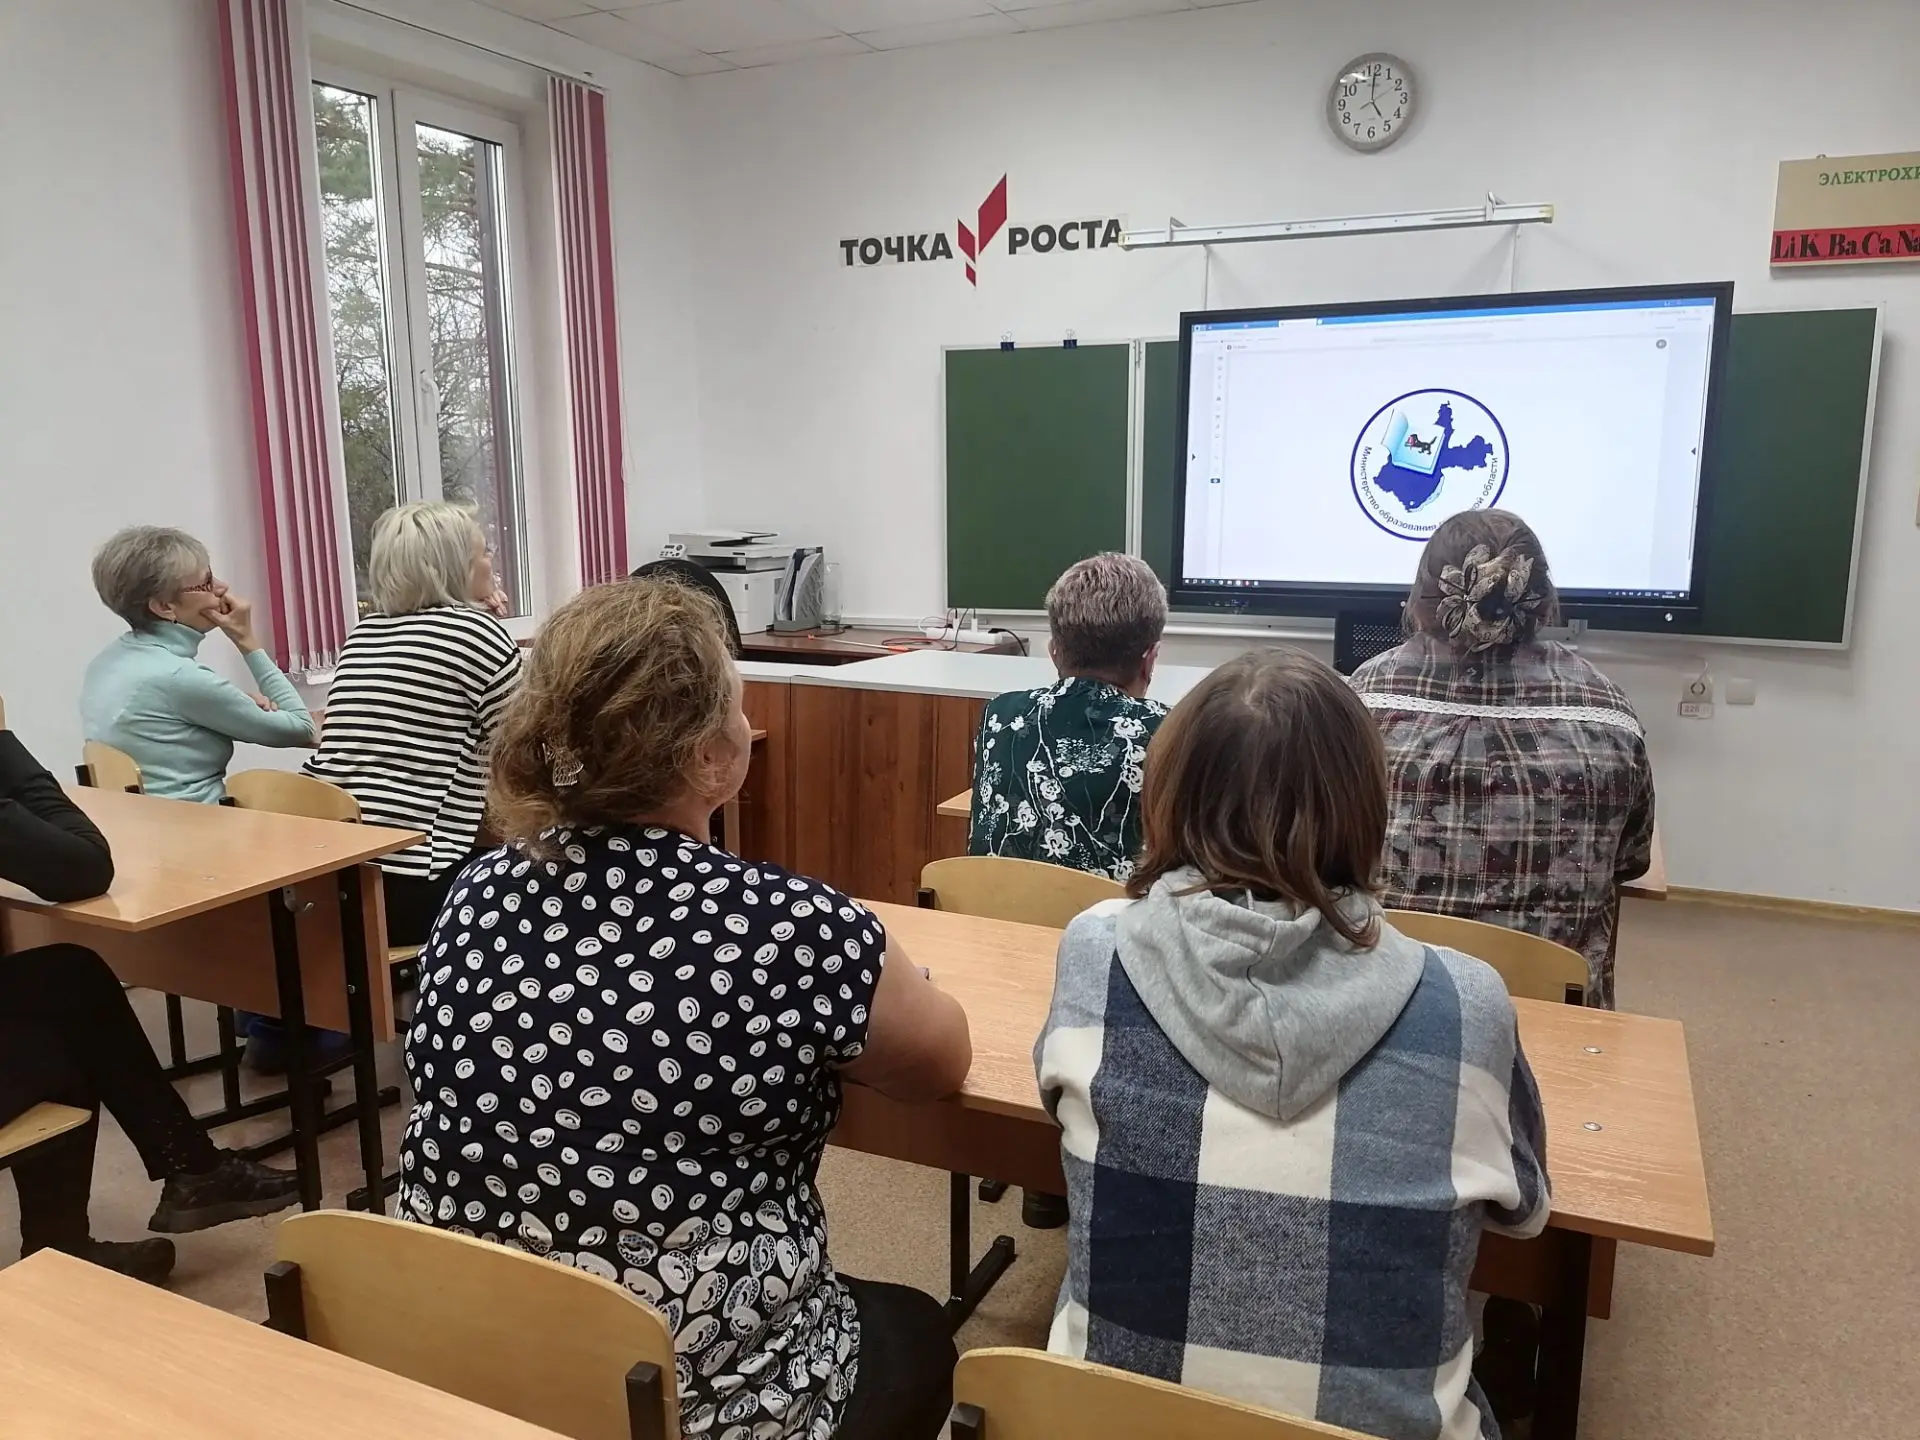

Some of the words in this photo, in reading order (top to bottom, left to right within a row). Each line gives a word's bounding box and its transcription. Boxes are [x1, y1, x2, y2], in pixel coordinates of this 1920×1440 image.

[1367, 64, 1382, 77] 12
[1386, 67, 1392, 80] 1
[1343, 83, 1357, 97] 10
[1394, 78, 1403, 91] 2
[1338, 99, 1346, 111] 9
[1400, 92, 1408, 105] 3
[1342, 112, 1351, 124] 8
[1393, 107, 1402, 119] 4
[1353, 123, 1361, 135] 7
[1367, 126, 1375, 138] 6
[1383, 120, 1391, 132] 5
[840, 233, 953, 266] ТОЧКА
[1008, 219, 1123, 255] РОСТА
[1774, 235, 1796, 259] Li
[1828, 233, 1857, 257] Ba
[1861, 231, 1892, 256] Ca
[1360, 446, 1380, 510] Министерство
[1482, 457, 1499, 496] области
